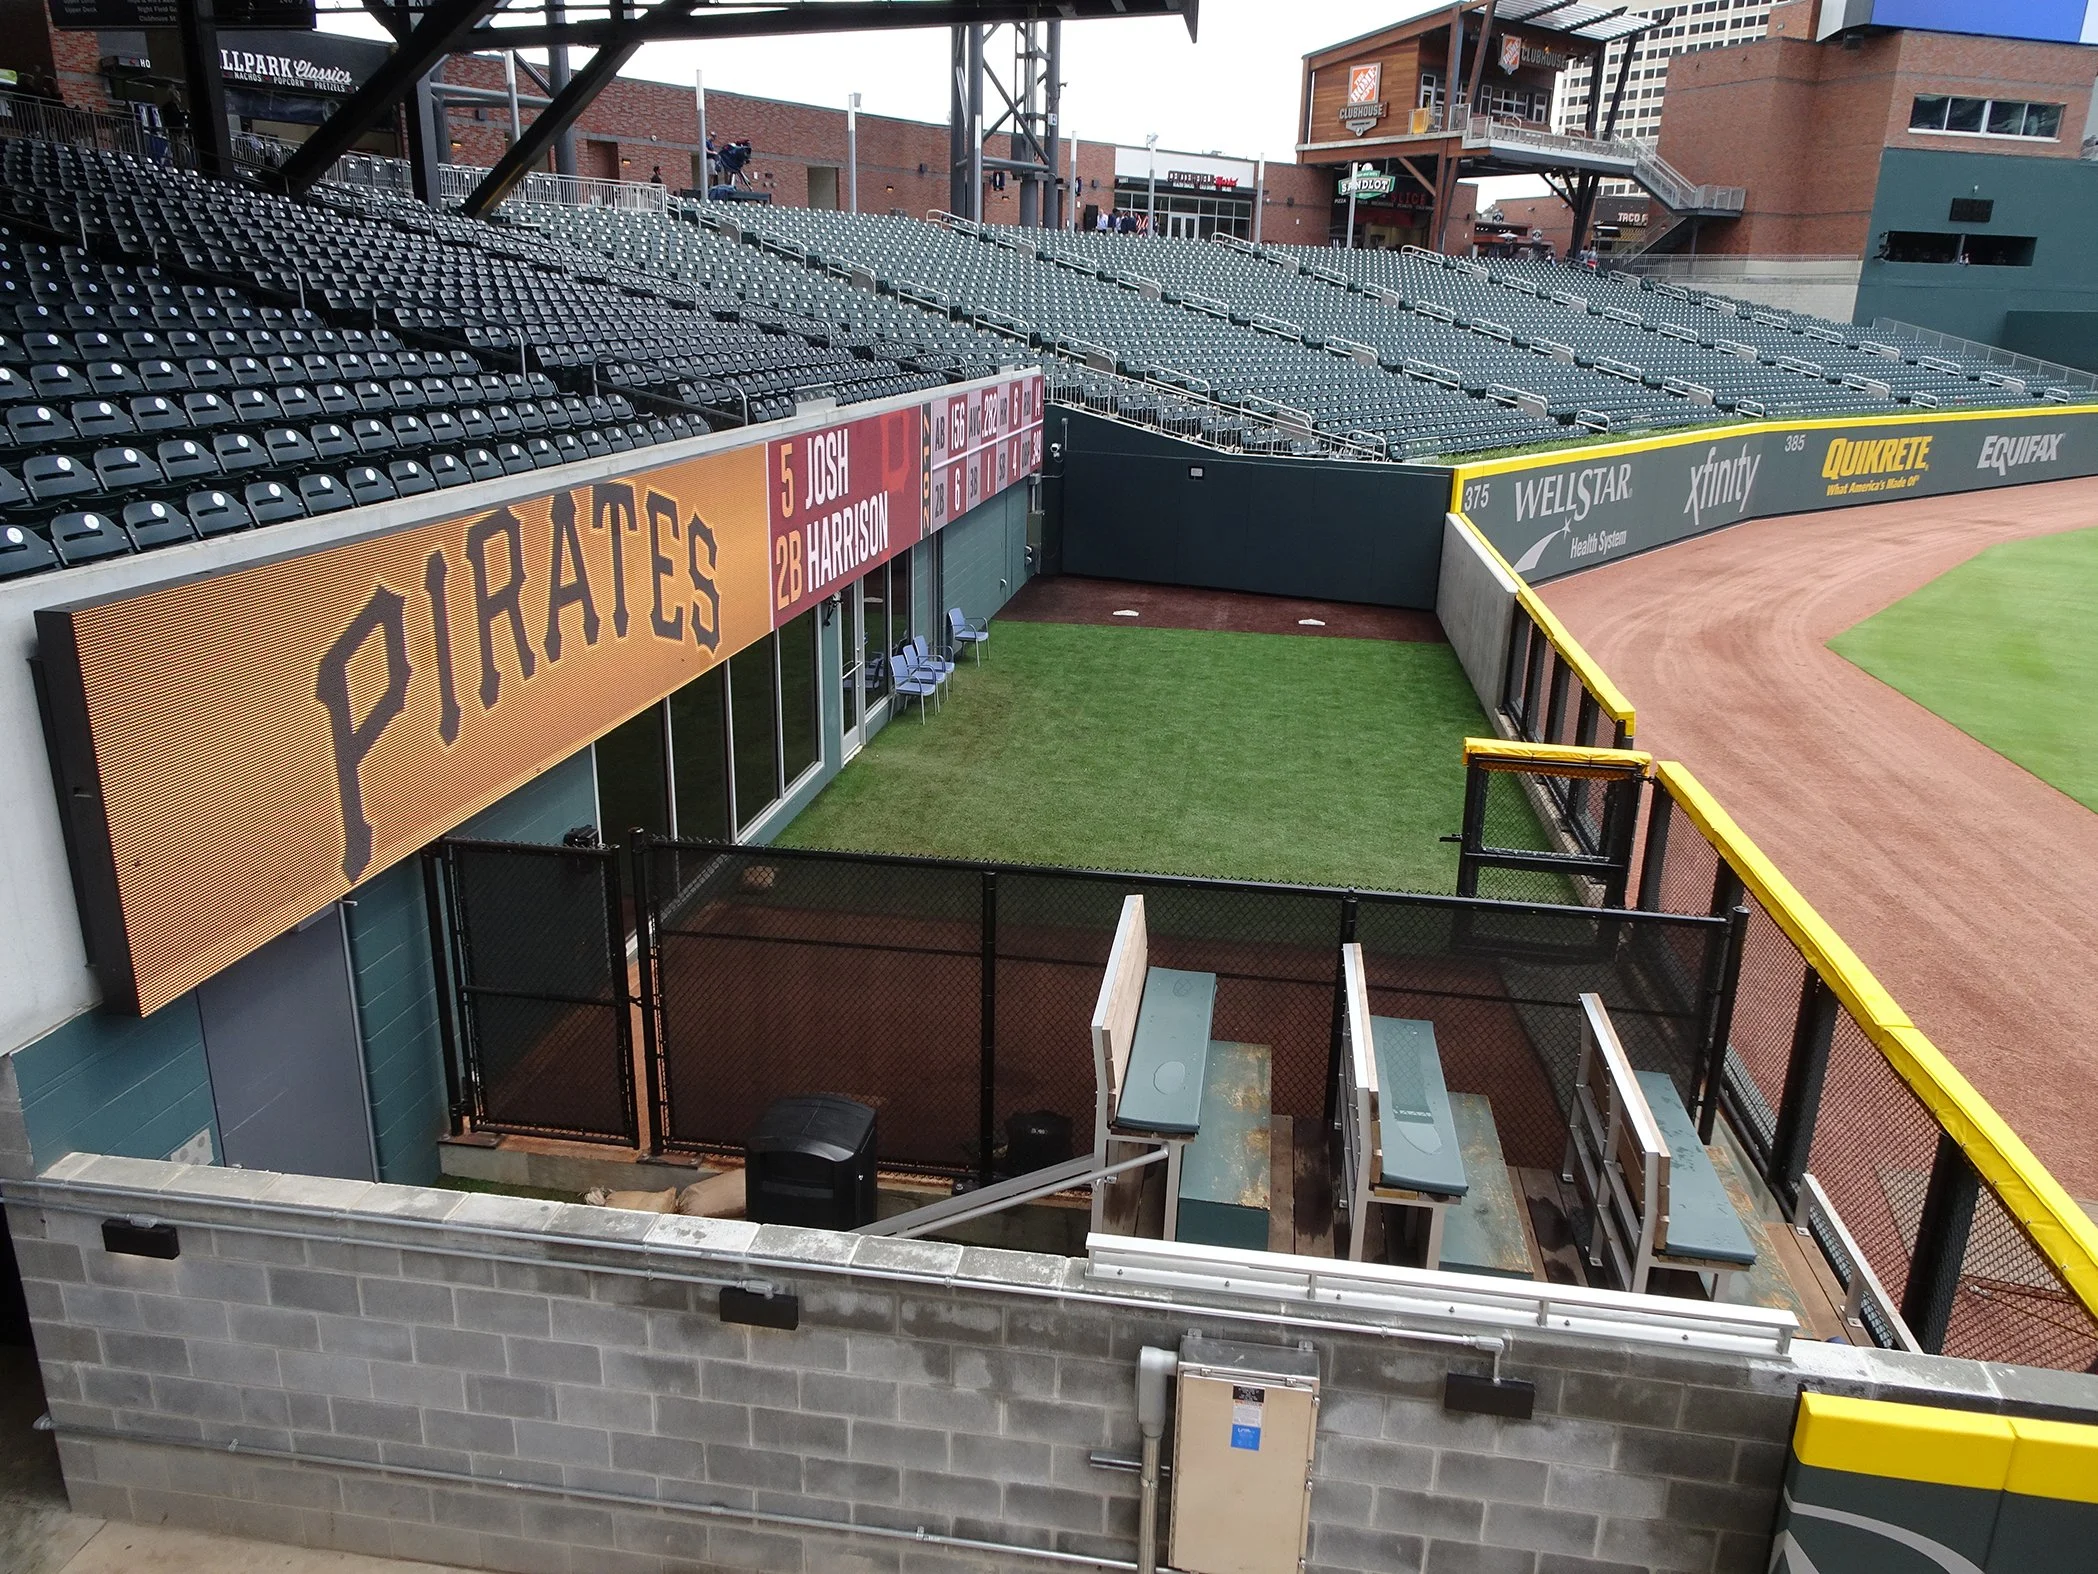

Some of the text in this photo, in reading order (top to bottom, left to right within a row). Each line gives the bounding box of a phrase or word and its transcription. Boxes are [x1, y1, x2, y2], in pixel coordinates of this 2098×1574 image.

[220, 49, 352, 85] LLPARK Classics
[1521, 47, 1567, 69] CLUBHOUSE
[234, 72, 262, 83] NACHOS
[273, 77, 305, 88] POPCORN
[314, 81, 346, 93] PRETZELS
[1351, 66, 1377, 103] HOME
[1340, 105, 1383, 120] CLUBHOUSE
[1617, 212, 1641, 223] TACO
[935, 416, 945, 452] AB
[951, 401, 966, 451] 156
[968, 405, 981, 439] AVG
[981, 393, 998, 438] .282
[1013, 387, 1019, 426] 6
[1035, 381, 1041, 417] 14
[1784, 434, 1806, 452] 385
[1821, 436, 1933, 480] QUIKRETE
[1976, 433, 2063, 477] EQUIFAX
[781, 443, 794, 518] 5
[805, 428, 849, 510] JOSH
[935, 482, 945, 518] 2B
[954, 467, 961, 512] 6
[970, 466, 978, 498] 3B
[987, 453, 991, 493] 1
[1012, 440, 1017, 477] 4
[1683, 442, 1761, 526] xfinity
[1826, 483, 1849, 496] What
[1848, 479, 1886, 494] America's
[1885, 477, 1907, 490] Made
[1464, 483, 1490, 512] 375
[1515, 463, 1632, 522] WELLSTAR
[806, 490, 889, 593] HARRISON
[1569, 530, 1627, 559] Health System
[776, 530, 803, 611] 2B
[315, 483, 721, 884] PIRATES
